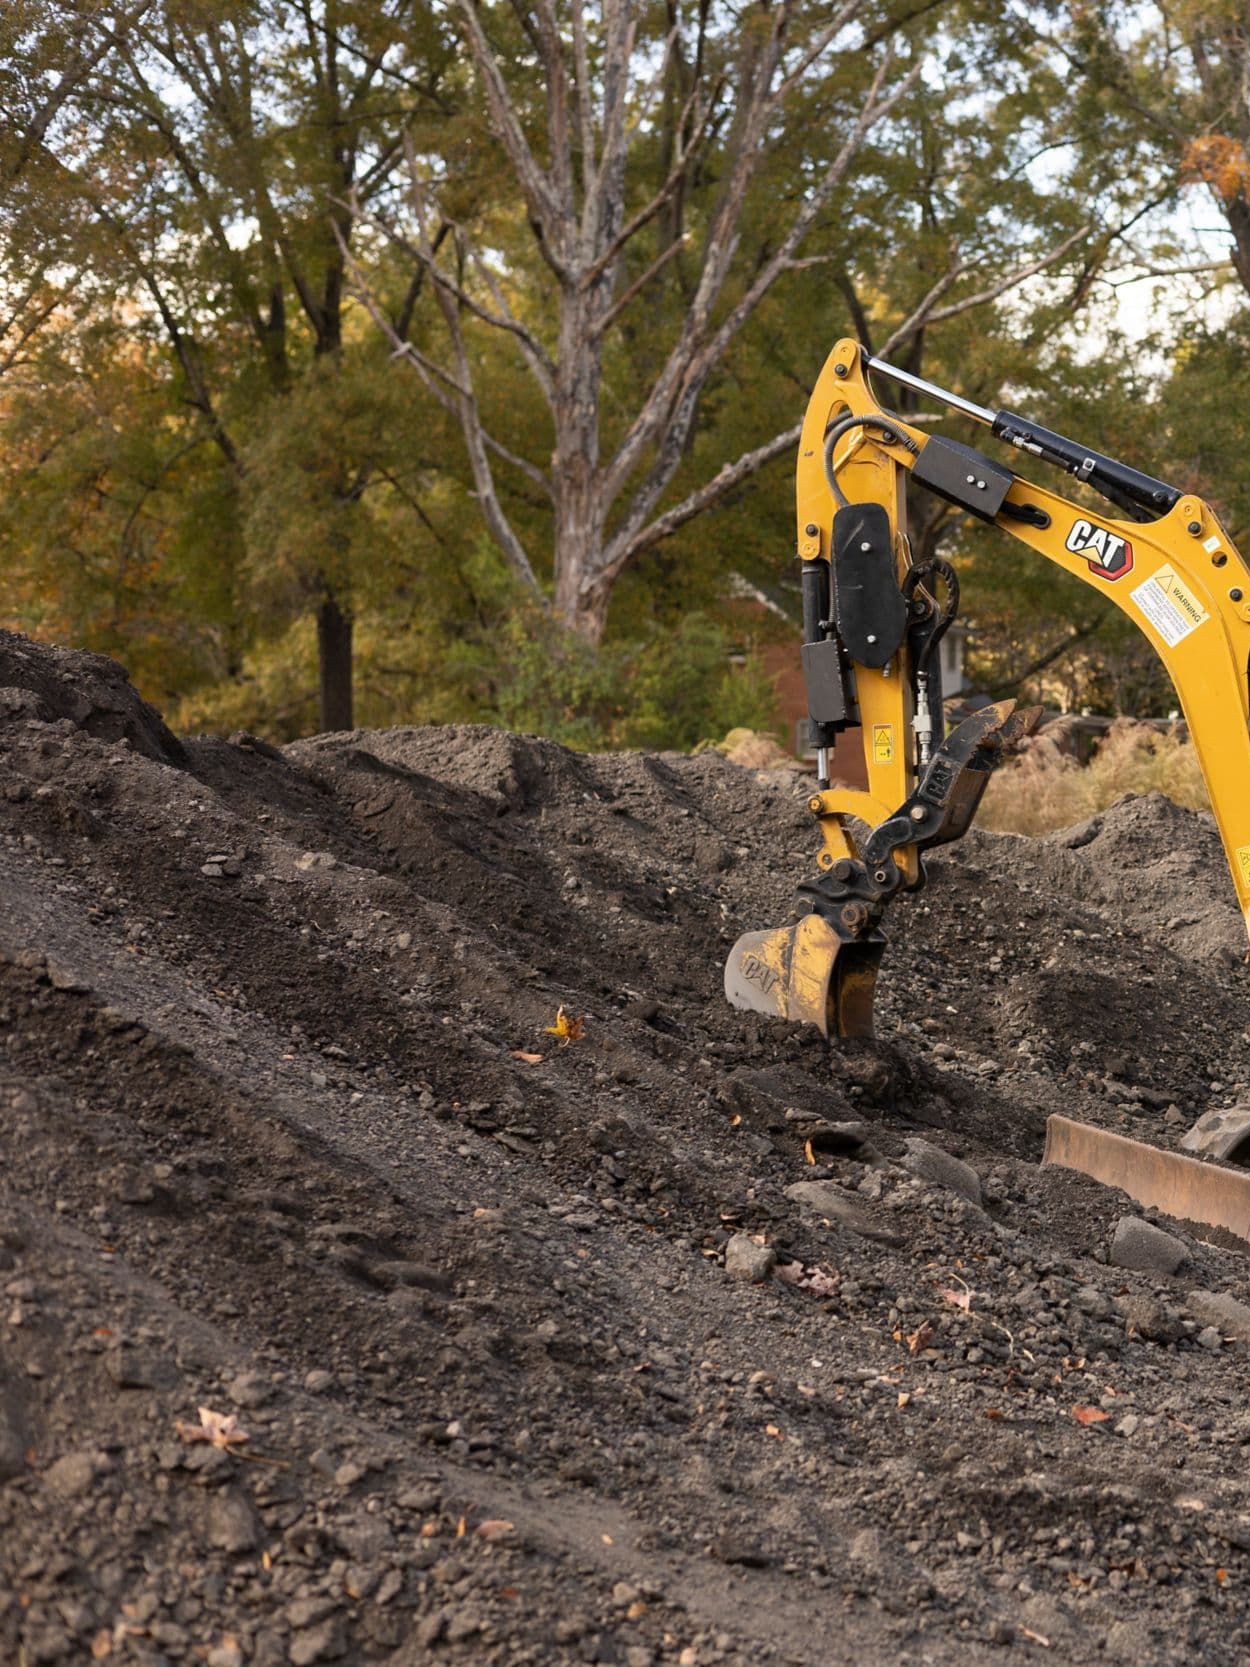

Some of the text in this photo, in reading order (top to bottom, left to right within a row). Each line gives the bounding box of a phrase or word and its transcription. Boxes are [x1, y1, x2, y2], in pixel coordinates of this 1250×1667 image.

[1066, 519, 1125, 568] CAT
[1172, 586, 1202, 623] WARNING
[742, 955, 780, 994] CAT
